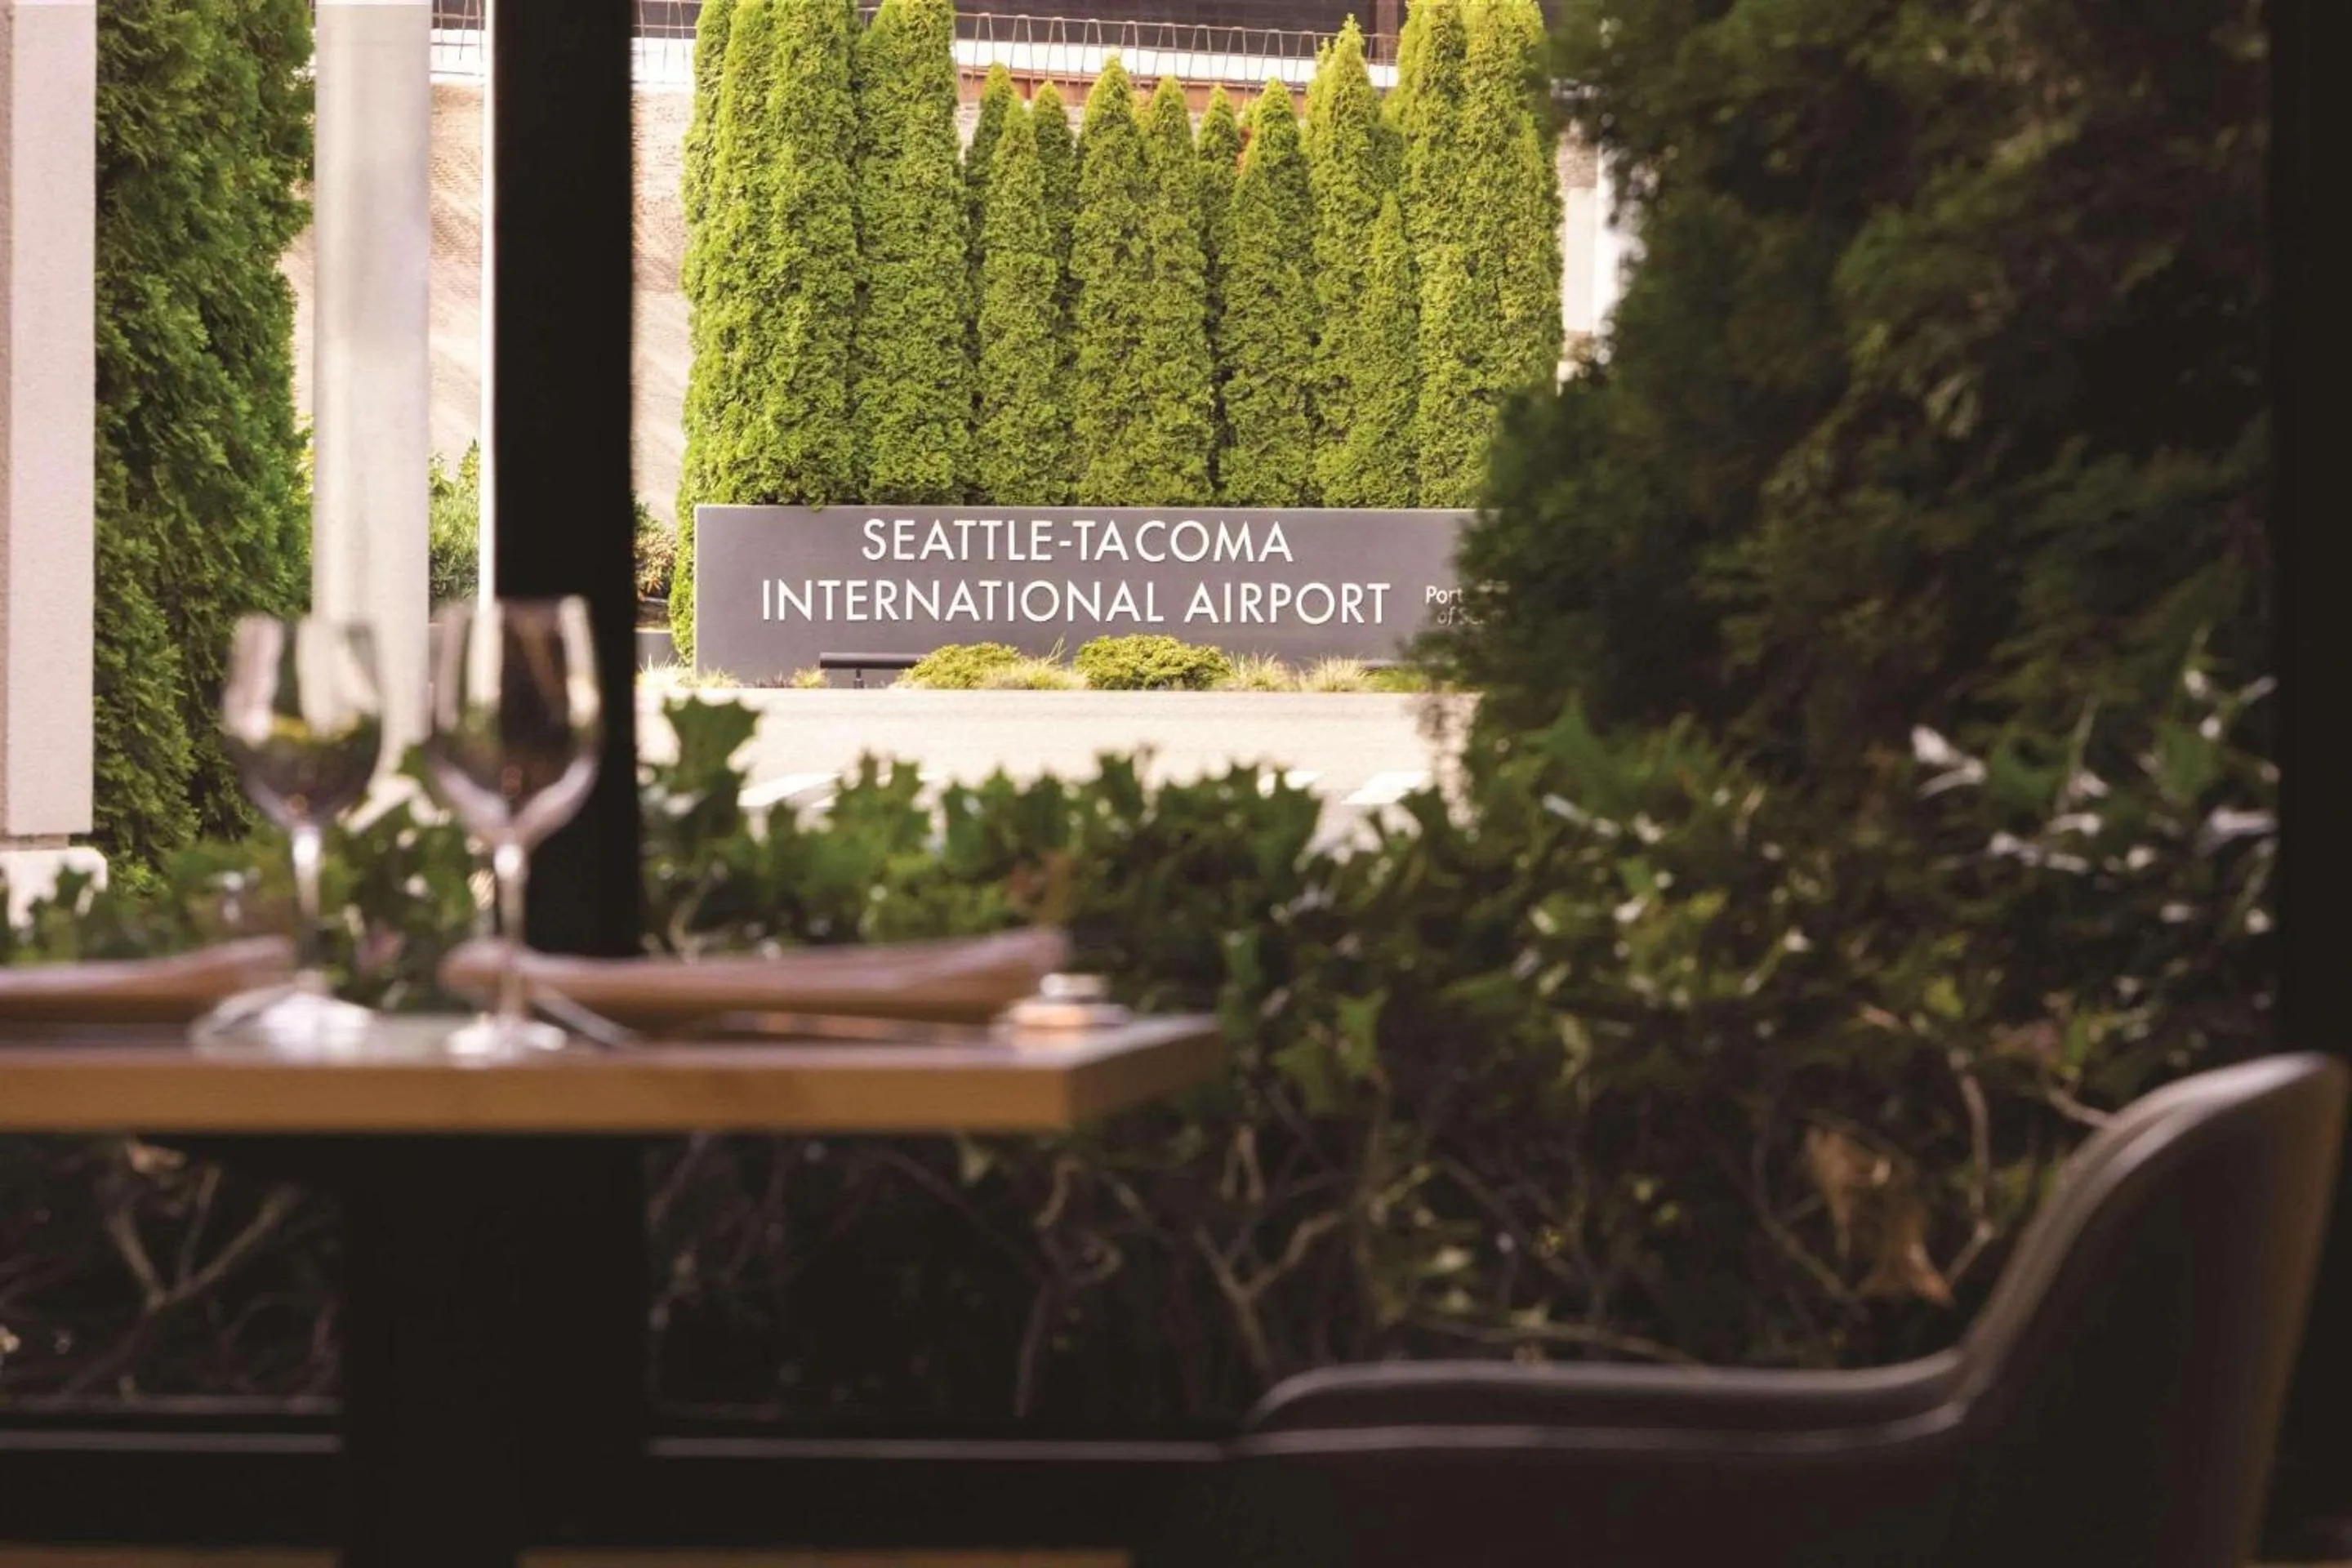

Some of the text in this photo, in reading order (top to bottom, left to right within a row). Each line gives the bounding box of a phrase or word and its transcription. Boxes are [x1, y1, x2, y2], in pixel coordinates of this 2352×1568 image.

[862, 518, 1294, 563] SEATTLE-TACOMA
[761, 579, 1391, 626] INTERNATIONAL AIRPORT
[1425, 585, 1463, 604] Port
